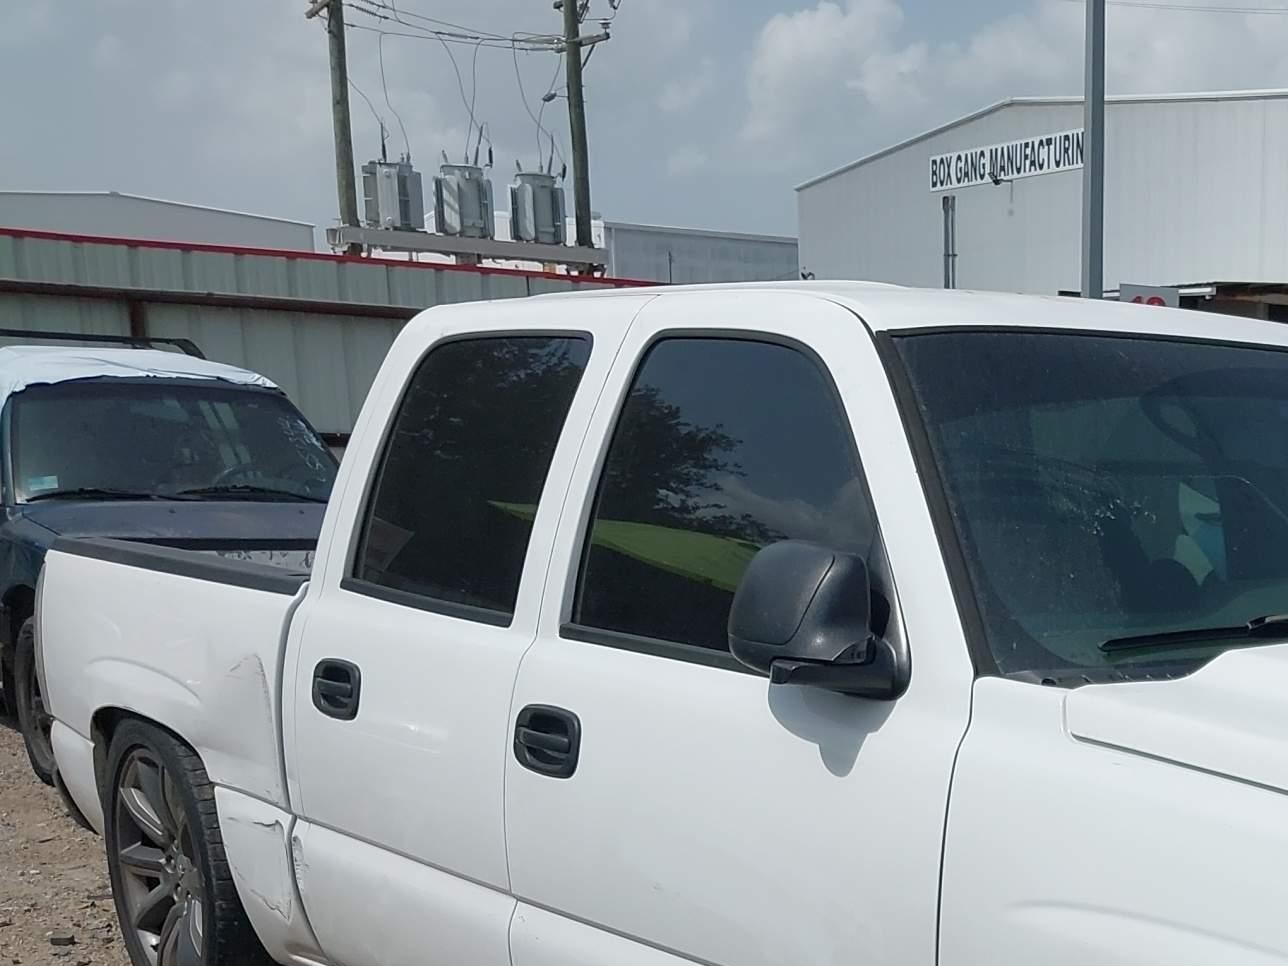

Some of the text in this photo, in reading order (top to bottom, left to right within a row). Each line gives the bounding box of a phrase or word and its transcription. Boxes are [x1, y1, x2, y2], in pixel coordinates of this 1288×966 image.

[931, 132, 1084, 188] BOX GANG MANUFACTURIN
